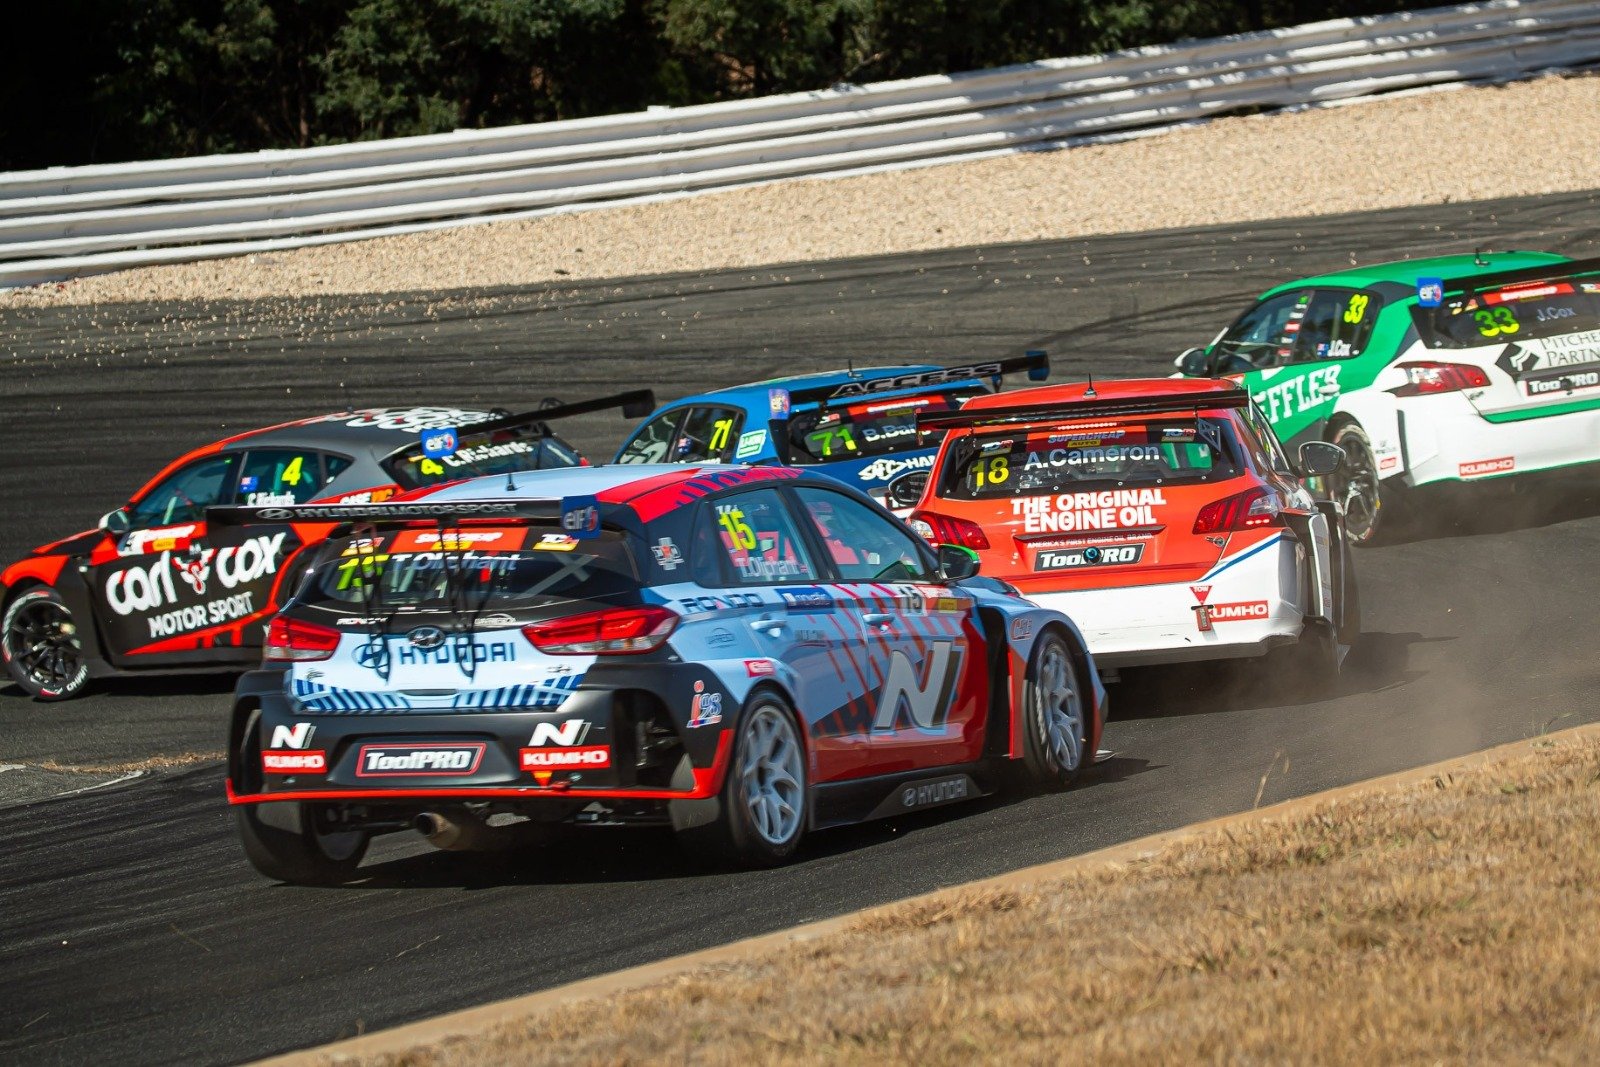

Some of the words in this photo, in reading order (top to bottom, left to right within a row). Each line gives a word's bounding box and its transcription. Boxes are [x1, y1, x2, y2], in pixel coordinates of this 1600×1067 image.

[1344, 294, 1368, 323] 33
[1475, 307, 1520, 336] 33
[1537, 306, 1577, 322] J.Cox
[830, 363, 1001, 397] ACCESS
[709, 419, 733, 450] 71
[811, 425, 857, 456] 71
[1048, 430, 1126, 444] SUPERCHEAP
[281, 457, 303, 485] 4
[421, 459, 444, 475] 4
[1024, 443, 1160, 471] A.Cameron
[1460, 459, 1513, 474] KUMHO
[971, 457, 1009, 487] 18
[1011, 497, 1051, 515] THE
[1056, 488, 1167, 511] ORIGINAL
[719, 508, 757, 551] 15
[1025, 508, 1117, 533] ENGINE
[1119, 505, 1157, 527] OIL
[1066, 538, 1086, 547] FIRST
[1087, 536, 1114, 544] ENGINE
[106, 551, 178, 615] carl
[337, 555, 389, 592] 15
[147, 604, 208, 638] MOTOR
[207, 591, 254, 624] SPORT
[400, 641, 516, 666] HYUNDAI
[871, 641, 958, 729] N
[270, 723, 313, 749] N
[528, 719, 588, 746] N
[264, 755, 325, 768] KUMHO
[366, 751, 472, 770] ToolPRO
[523, 750, 609, 766] KUMHO
